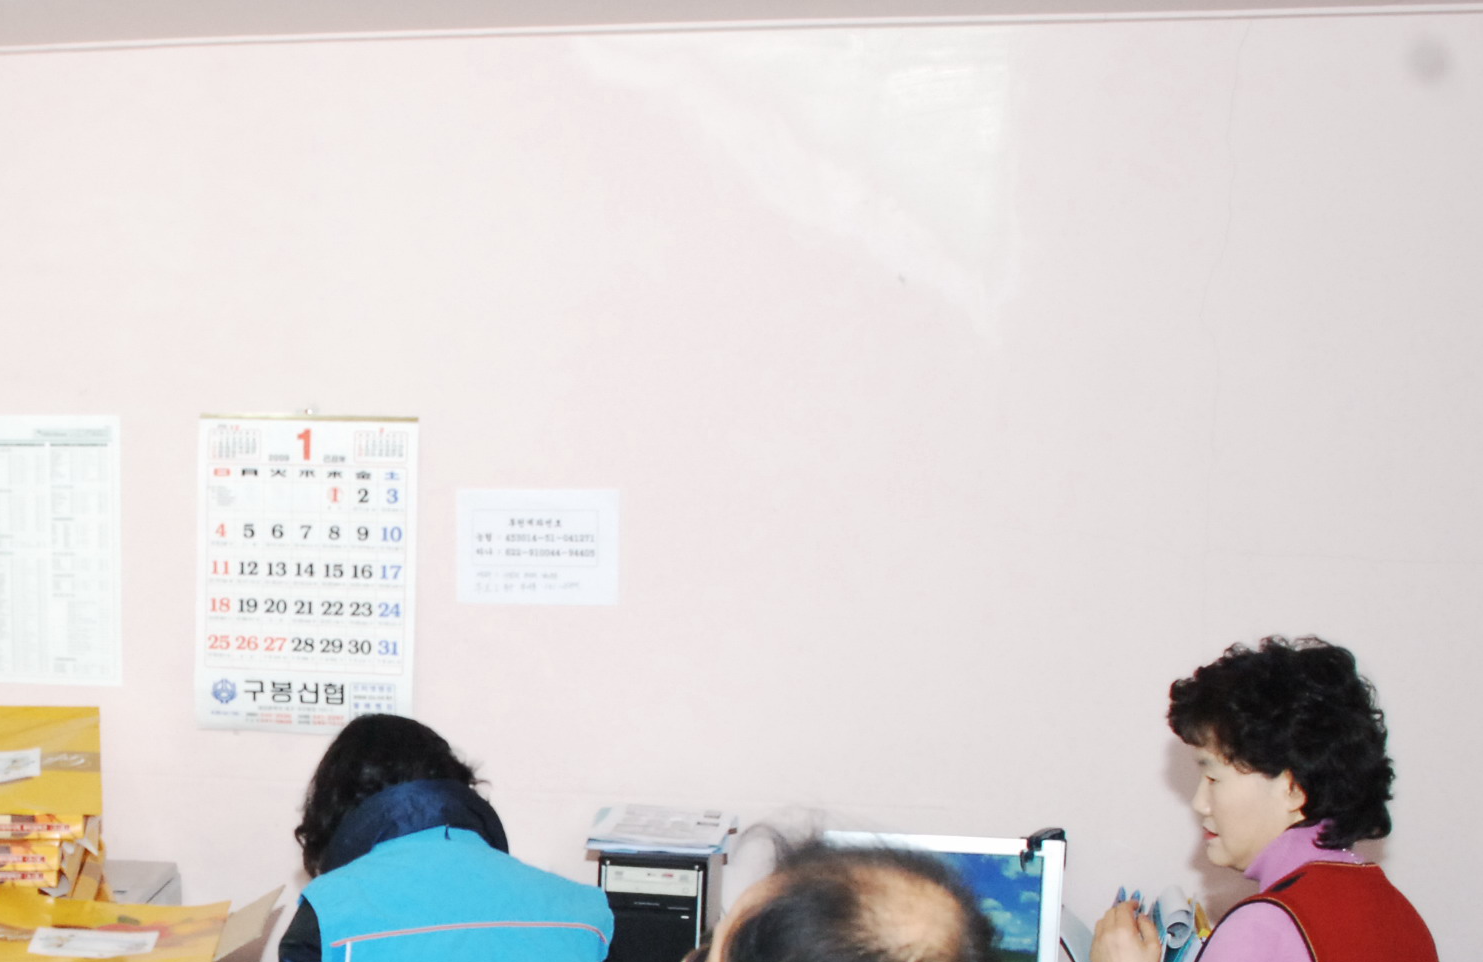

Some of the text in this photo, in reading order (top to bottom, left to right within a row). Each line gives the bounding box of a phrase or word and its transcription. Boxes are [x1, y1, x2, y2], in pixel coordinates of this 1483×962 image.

[297, 428, 311, 460] 1
[330, 487, 399, 505] 1 2 3
[215, 523, 402, 542] 4 5 6 7 8 9 10
[211, 560, 402, 580] 11 12 13 14 15 16 17
[210, 597, 402, 618] 18 19 20 21 22 23 24
[208, 635, 399, 656] 25 26 27 28 29 30 31
[244, 679, 345, 705] 구봉신협
